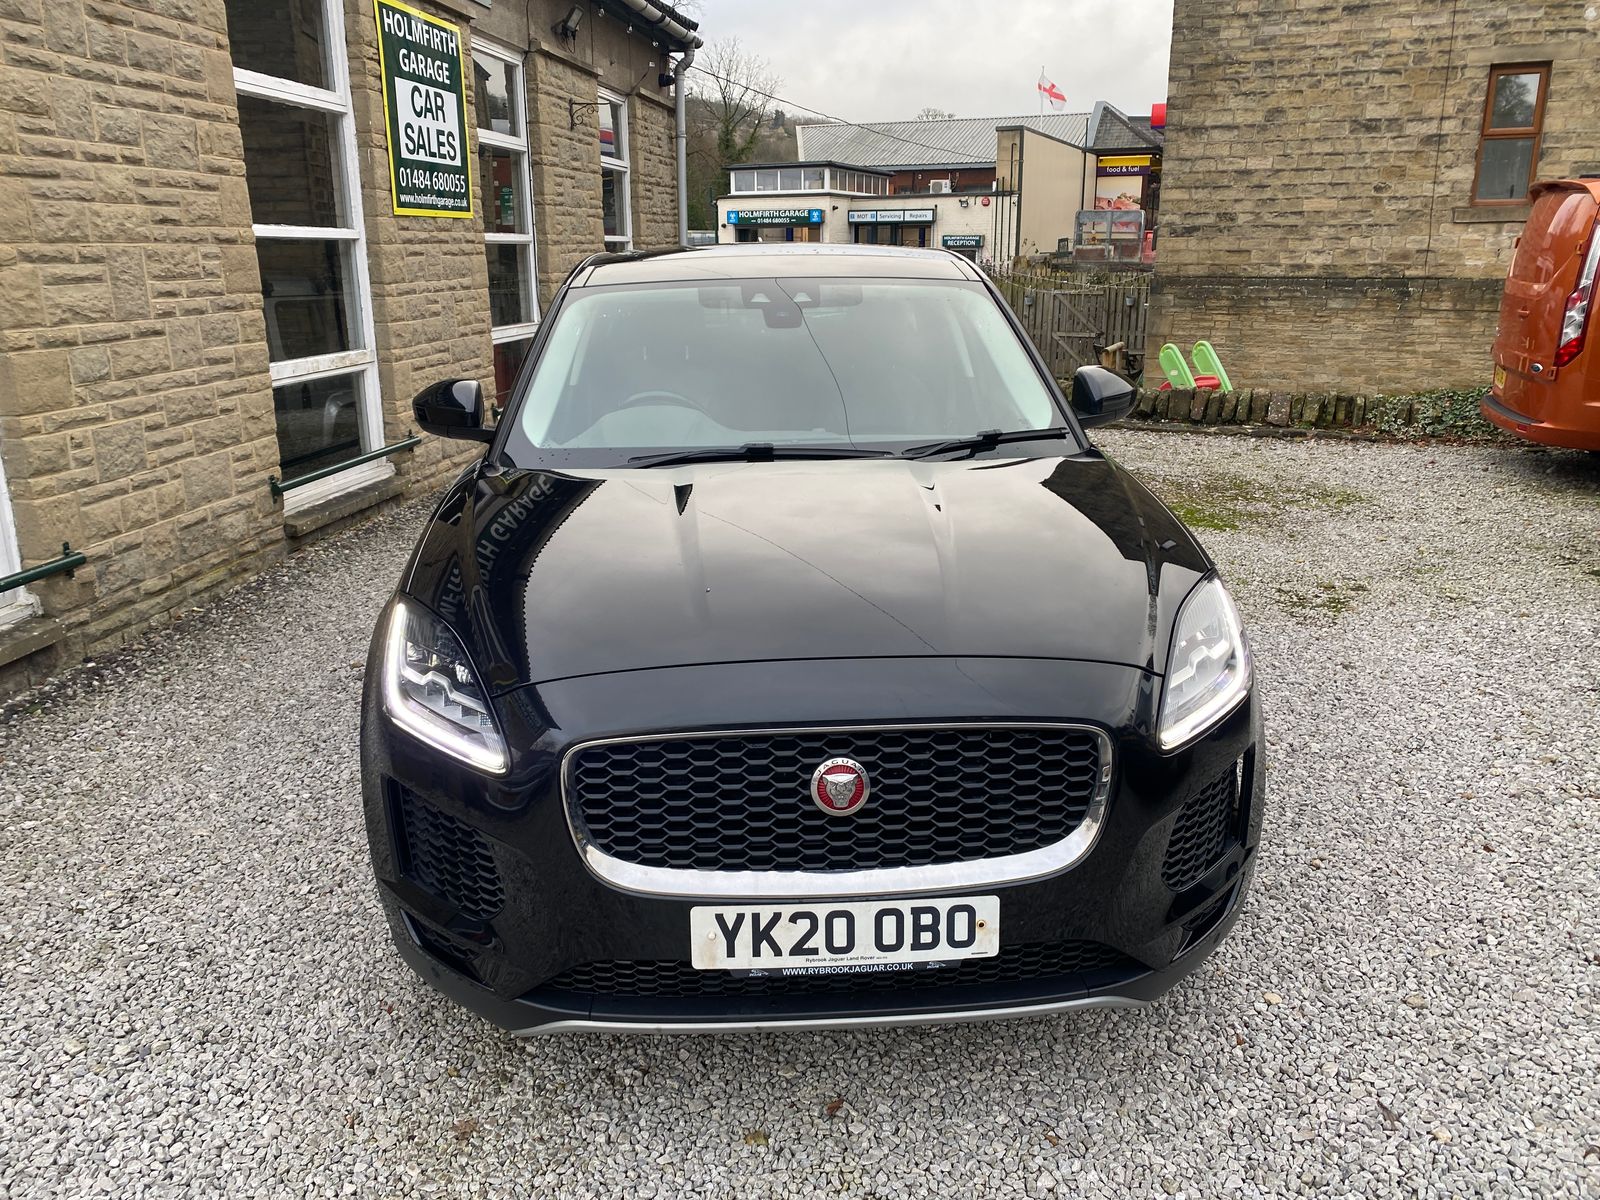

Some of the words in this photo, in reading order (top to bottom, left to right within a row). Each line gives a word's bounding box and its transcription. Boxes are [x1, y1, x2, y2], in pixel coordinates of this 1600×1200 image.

[383, 8, 457, 56] HOLMFIRTH
[399, 48, 450, 84] GARAGE
[410, 85, 446, 123] CAR
[404, 122, 457, 162] SALES
[400, 167, 431, 190] 01484
[432, 171, 465, 193] 680055
[399, 192, 468, 208] www.holmfirthgarage.co.uk
[738, 209, 779, 218] HOLMFIRTH
[779, 209, 809, 217] GARAGE
[816, 759, 865, 777] JAGUAR
[714, 909, 856, 958] YK20
[874, 904, 977, 953] OBO
[782, 962, 914, 976] WWW.RYBROOKJAGUAR.CO.UK
